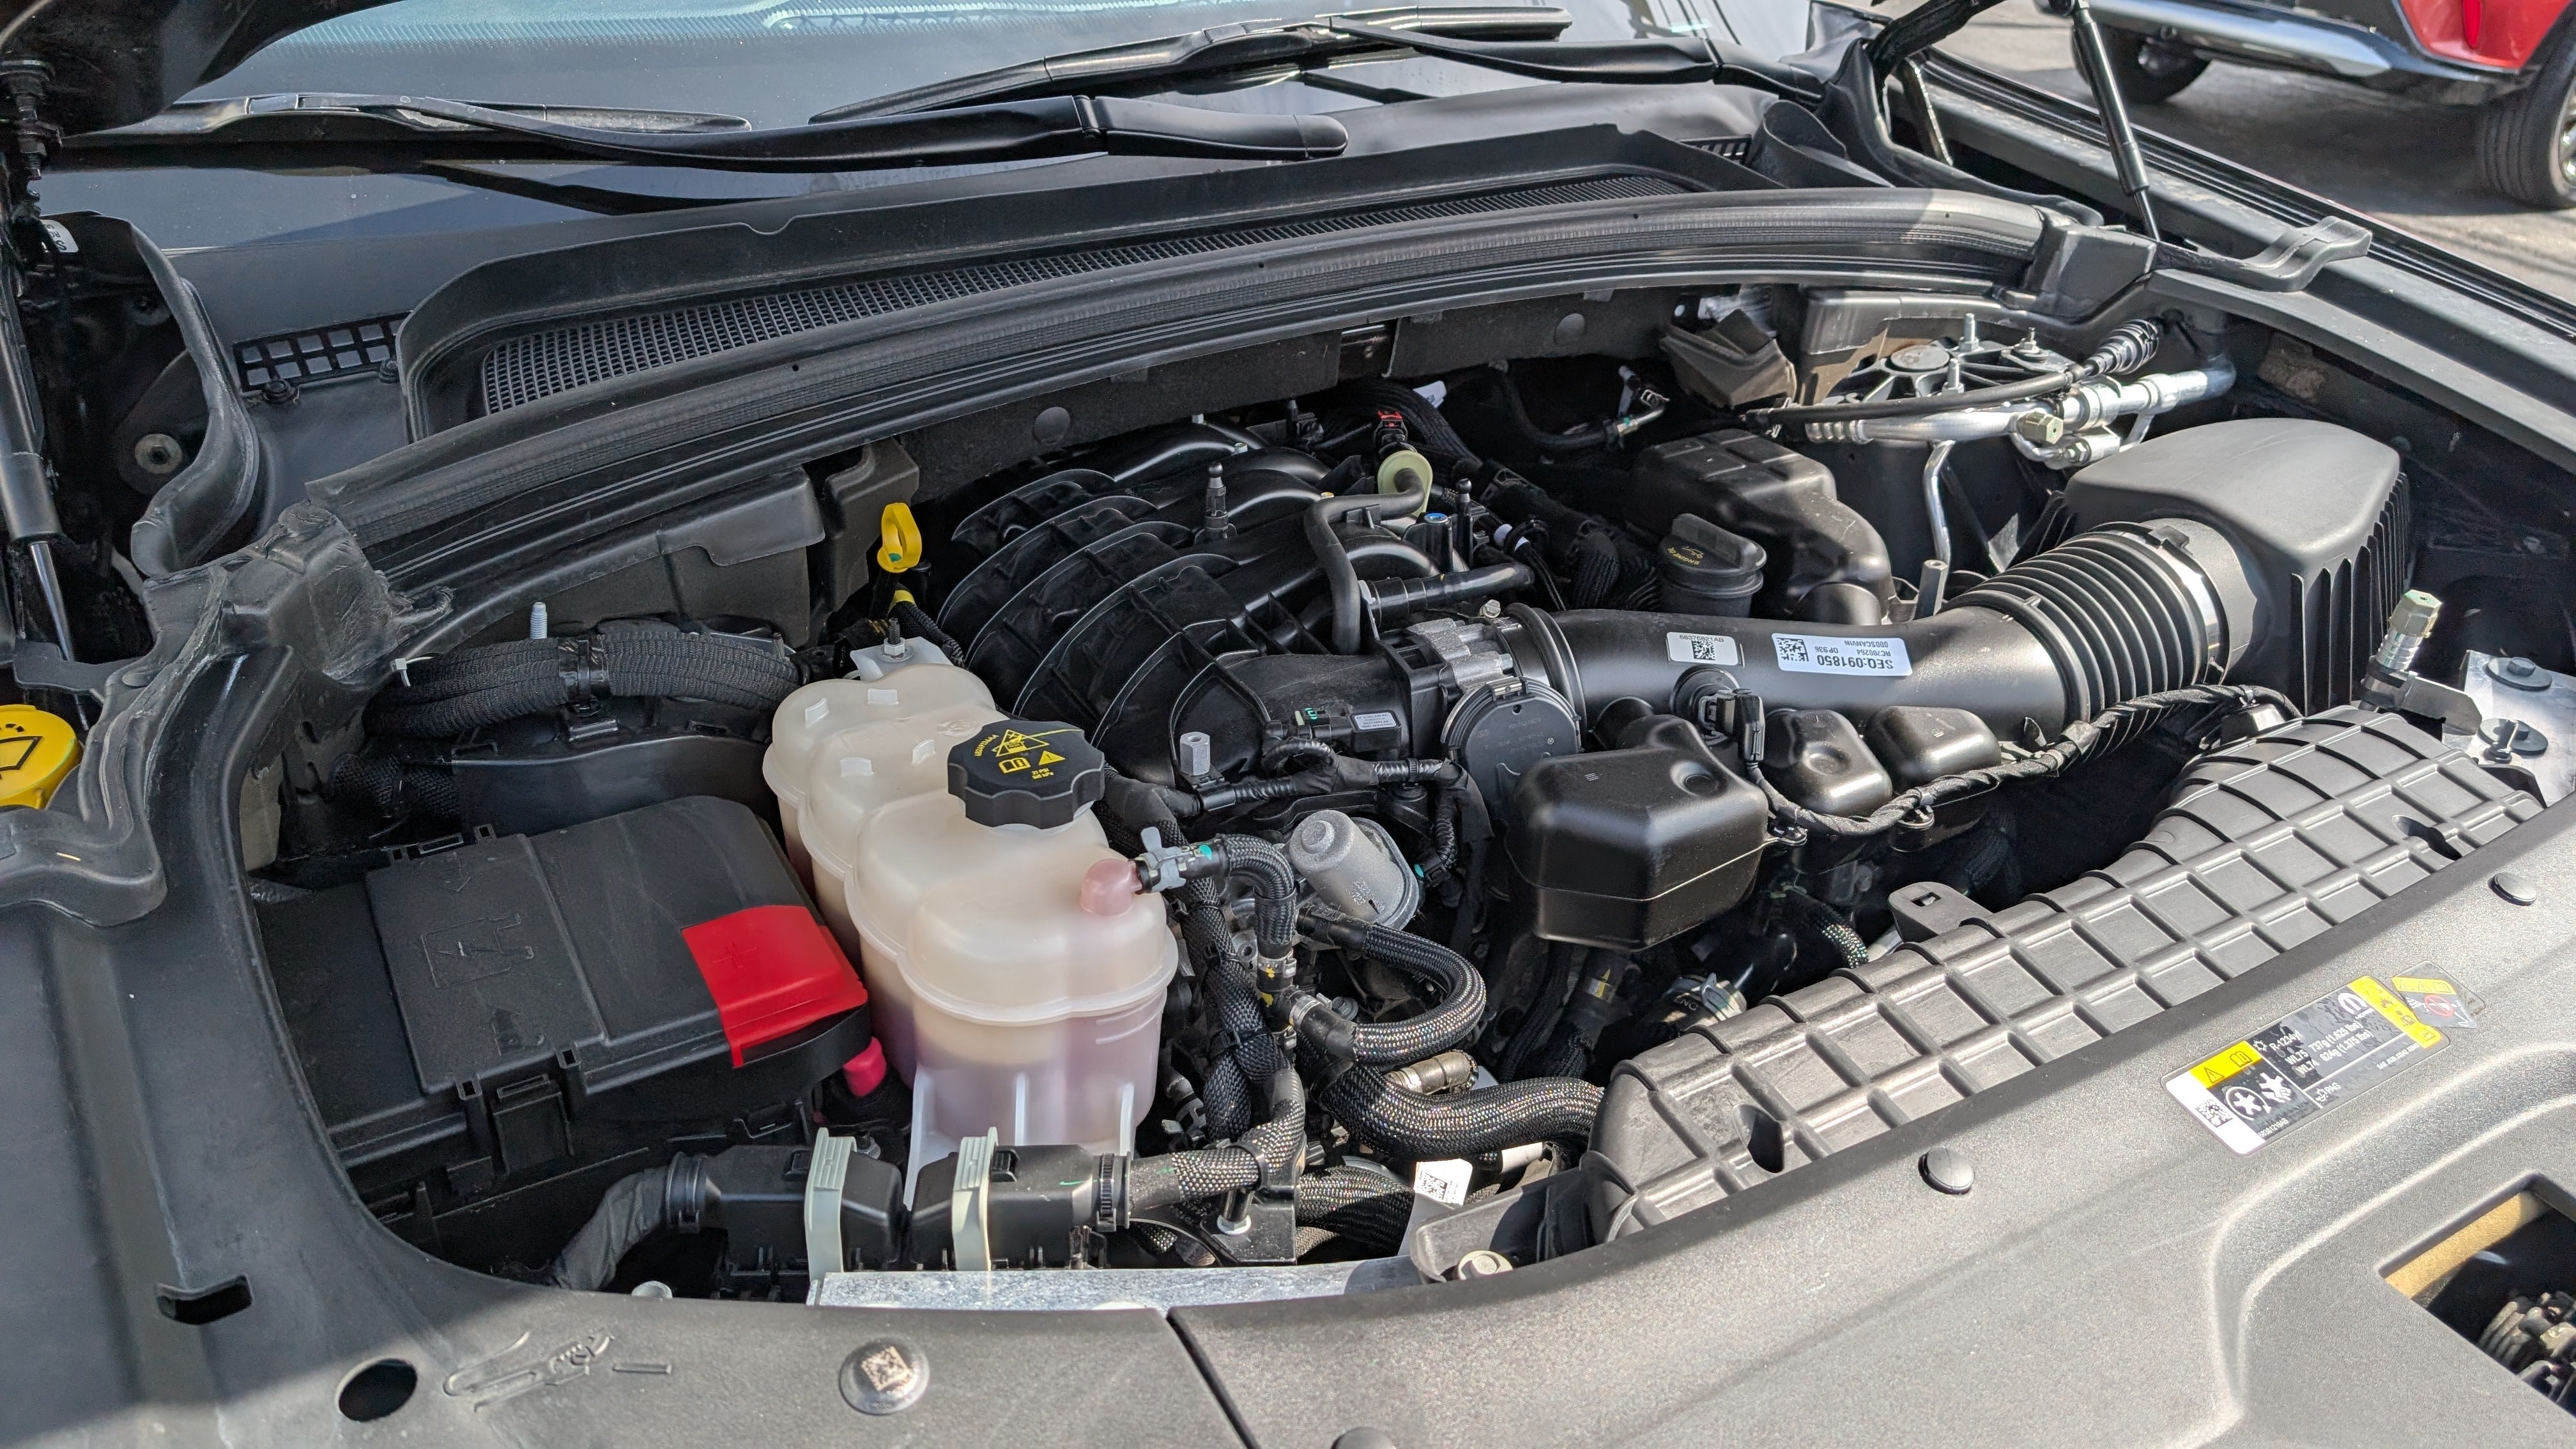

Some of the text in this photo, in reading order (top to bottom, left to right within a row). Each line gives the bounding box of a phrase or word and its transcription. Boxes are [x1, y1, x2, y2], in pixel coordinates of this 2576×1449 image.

[1673, 553, 1700, 565] ENGINE
[1856, 648, 1891, 657] RC700264
[1817, 654, 1894, 670] SEQ:091850
[2269, 1029, 2303, 1051] R-1234yf
[2285, 1020, 2364, 1065] WL75 737g (1.625 lbs)
[2296, 1029, 2374, 1074] WL74 624g (1.375 lbs)
[2324, 1082, 2342, 1094] PAG
